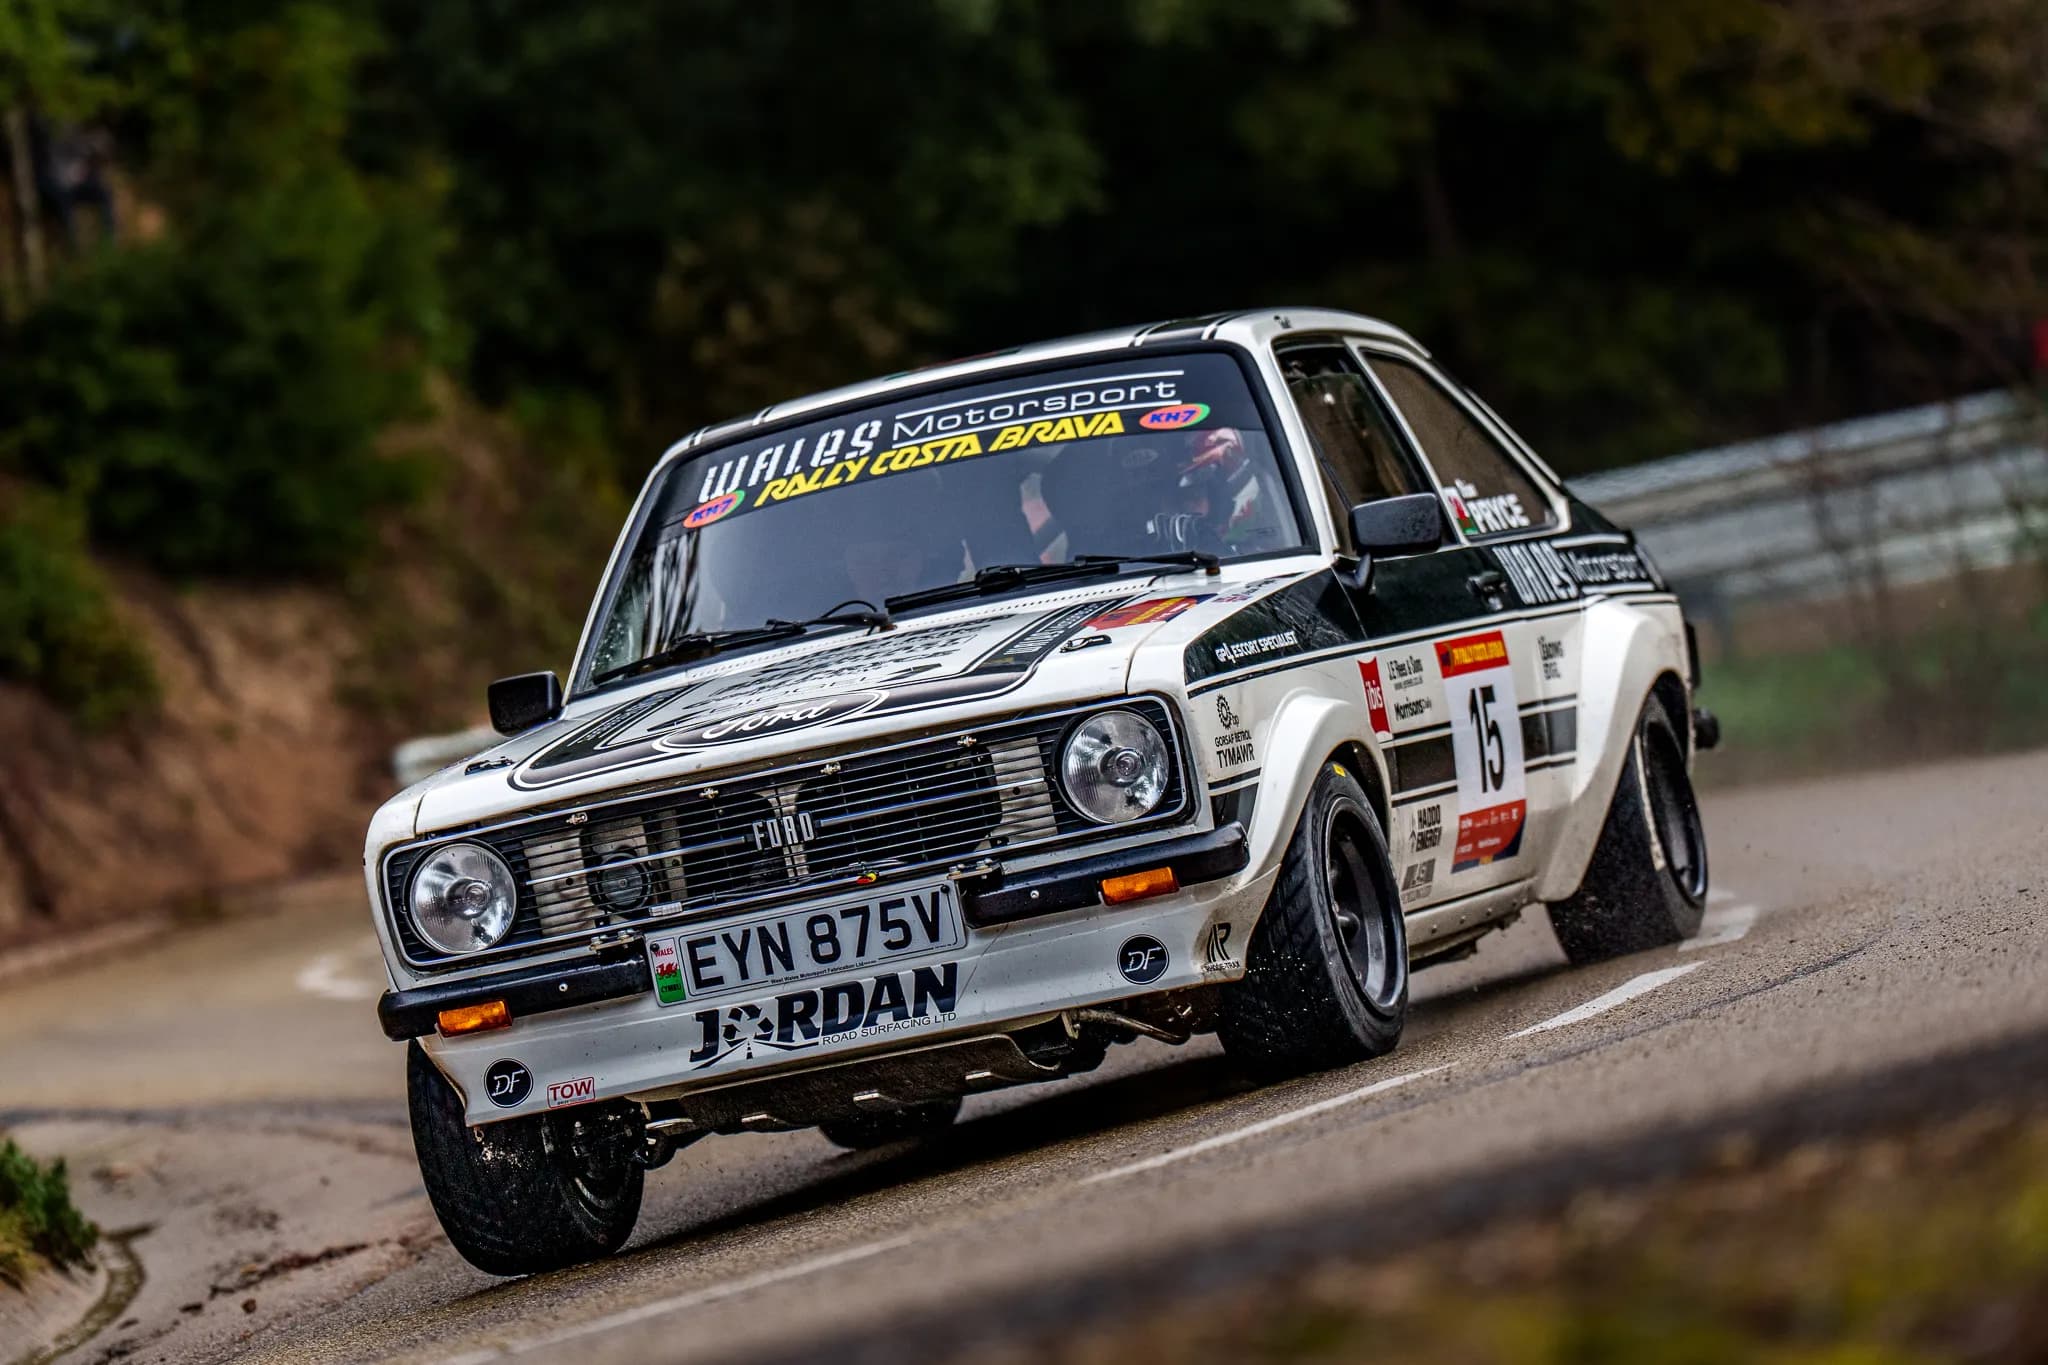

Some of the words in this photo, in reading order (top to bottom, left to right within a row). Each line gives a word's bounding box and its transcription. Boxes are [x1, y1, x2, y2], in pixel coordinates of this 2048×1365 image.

[893, 382, 1176, 441] Motorsport
[754, 456, 870, 507] RALLY
[870, 433, 983, 475] COSTA
[988, 412, 1125, 452] BRAVA
[1467, 493, 1530, 534] PRYCE
[1231, 644, 1260, 659] ESCORT
[1259, 631, 1298, 652] SPECIALIST
[1365, 680, 1384, 710] ibis
[702, 700, 838, 740] Ford
[1469, 685, 1504, 793] 15
[1217, 743, 1255, 768] TYMAWR
[752, 812, 814, 850] FORD
[655, 947, 674, 957] WALES
[686, 922, 795, 989] EYN
[806, 891, 940, 965] 875V
[822, 1031, 858, 1046] ROAD
[861, 1015, 931, 1038] SURFACING
[934, 1012, 957, 1025] LTD
[550, 1080, 592, 1101] TOW
